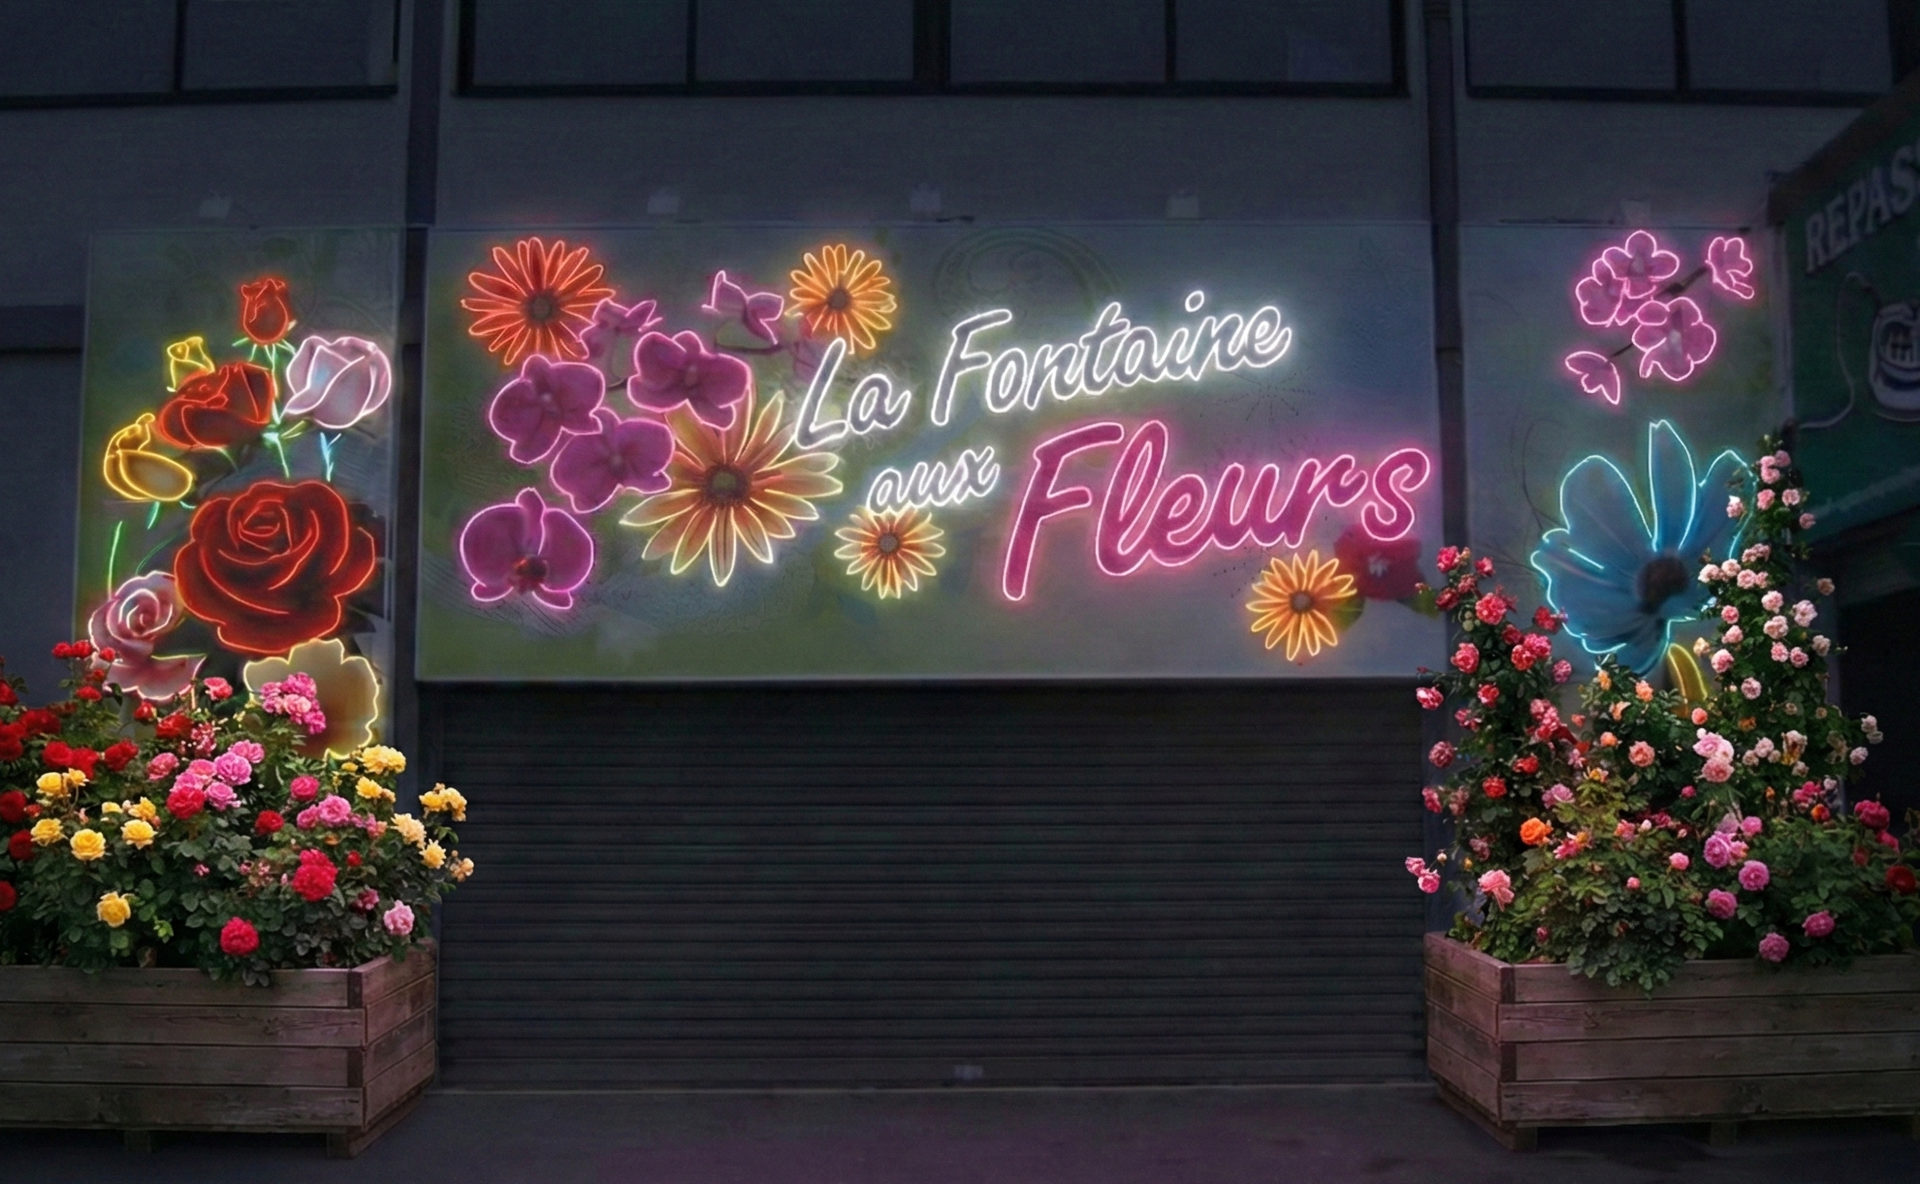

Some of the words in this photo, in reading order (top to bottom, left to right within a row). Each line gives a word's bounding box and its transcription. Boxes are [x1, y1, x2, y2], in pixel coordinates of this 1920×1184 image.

[1804, 137, 1920, 273] REPAS
[795, 337, 911, 449] La
[932, 290, 1292, 426] Fontaine
[865, 446, 1000, 515] aux
[1002, 420, 1431, 601] Fleurs
